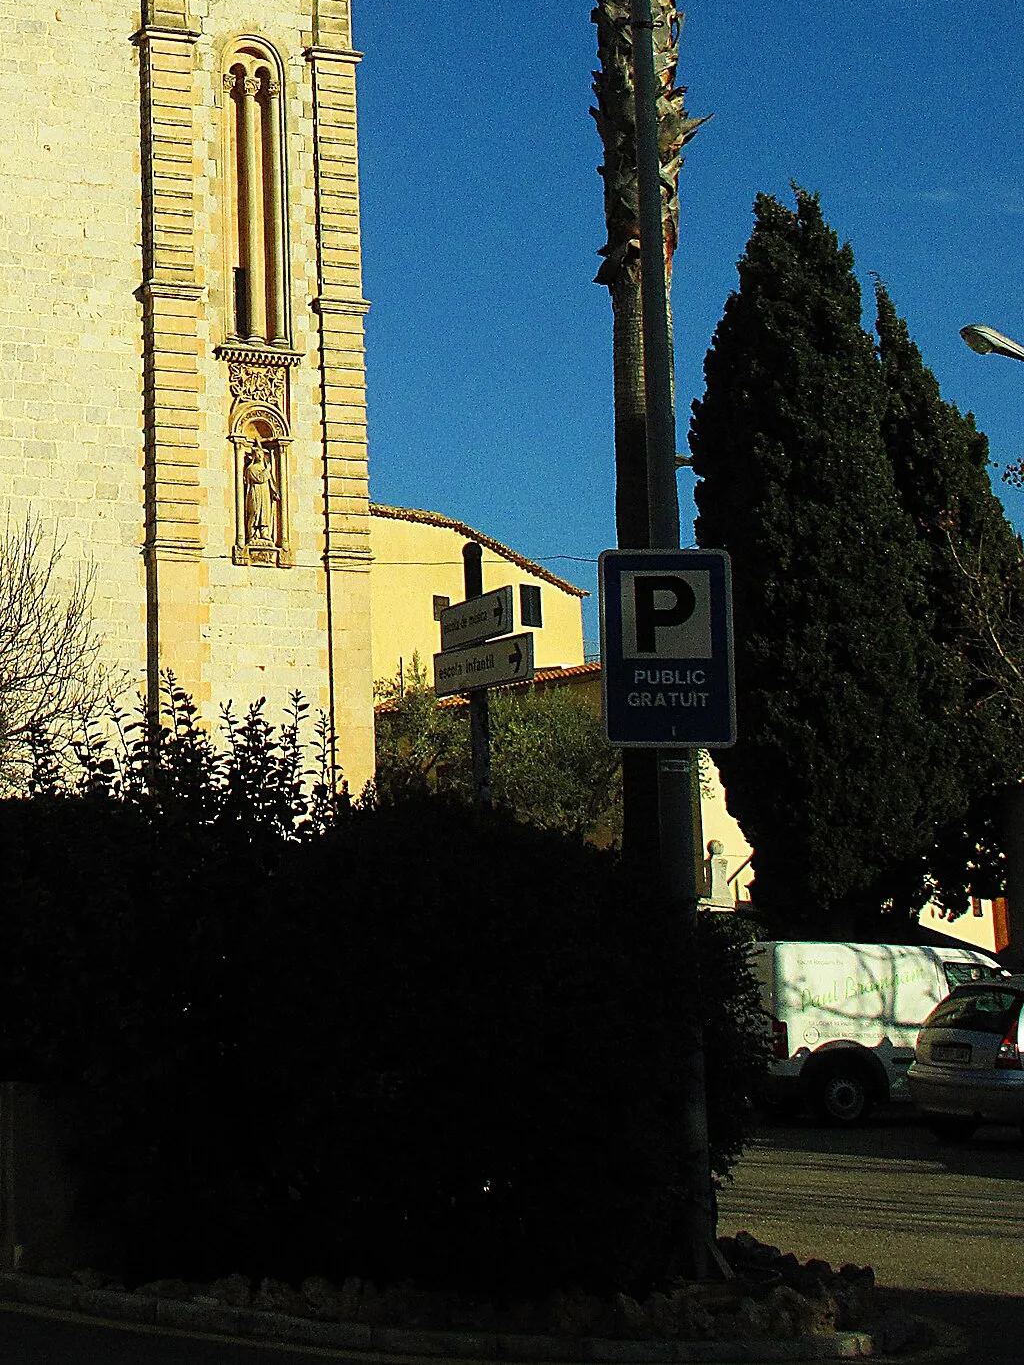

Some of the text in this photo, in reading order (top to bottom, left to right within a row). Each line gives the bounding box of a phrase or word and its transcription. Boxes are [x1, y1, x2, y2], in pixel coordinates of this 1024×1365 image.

[634, 575, 696, 653] P
[439, 653, 495, 680] escola infantil
[634, 670, 707, 685] PUBLIC
[627, 692, 710, 707] GRATUIT
[802, 980, 838, 1012] Paul
